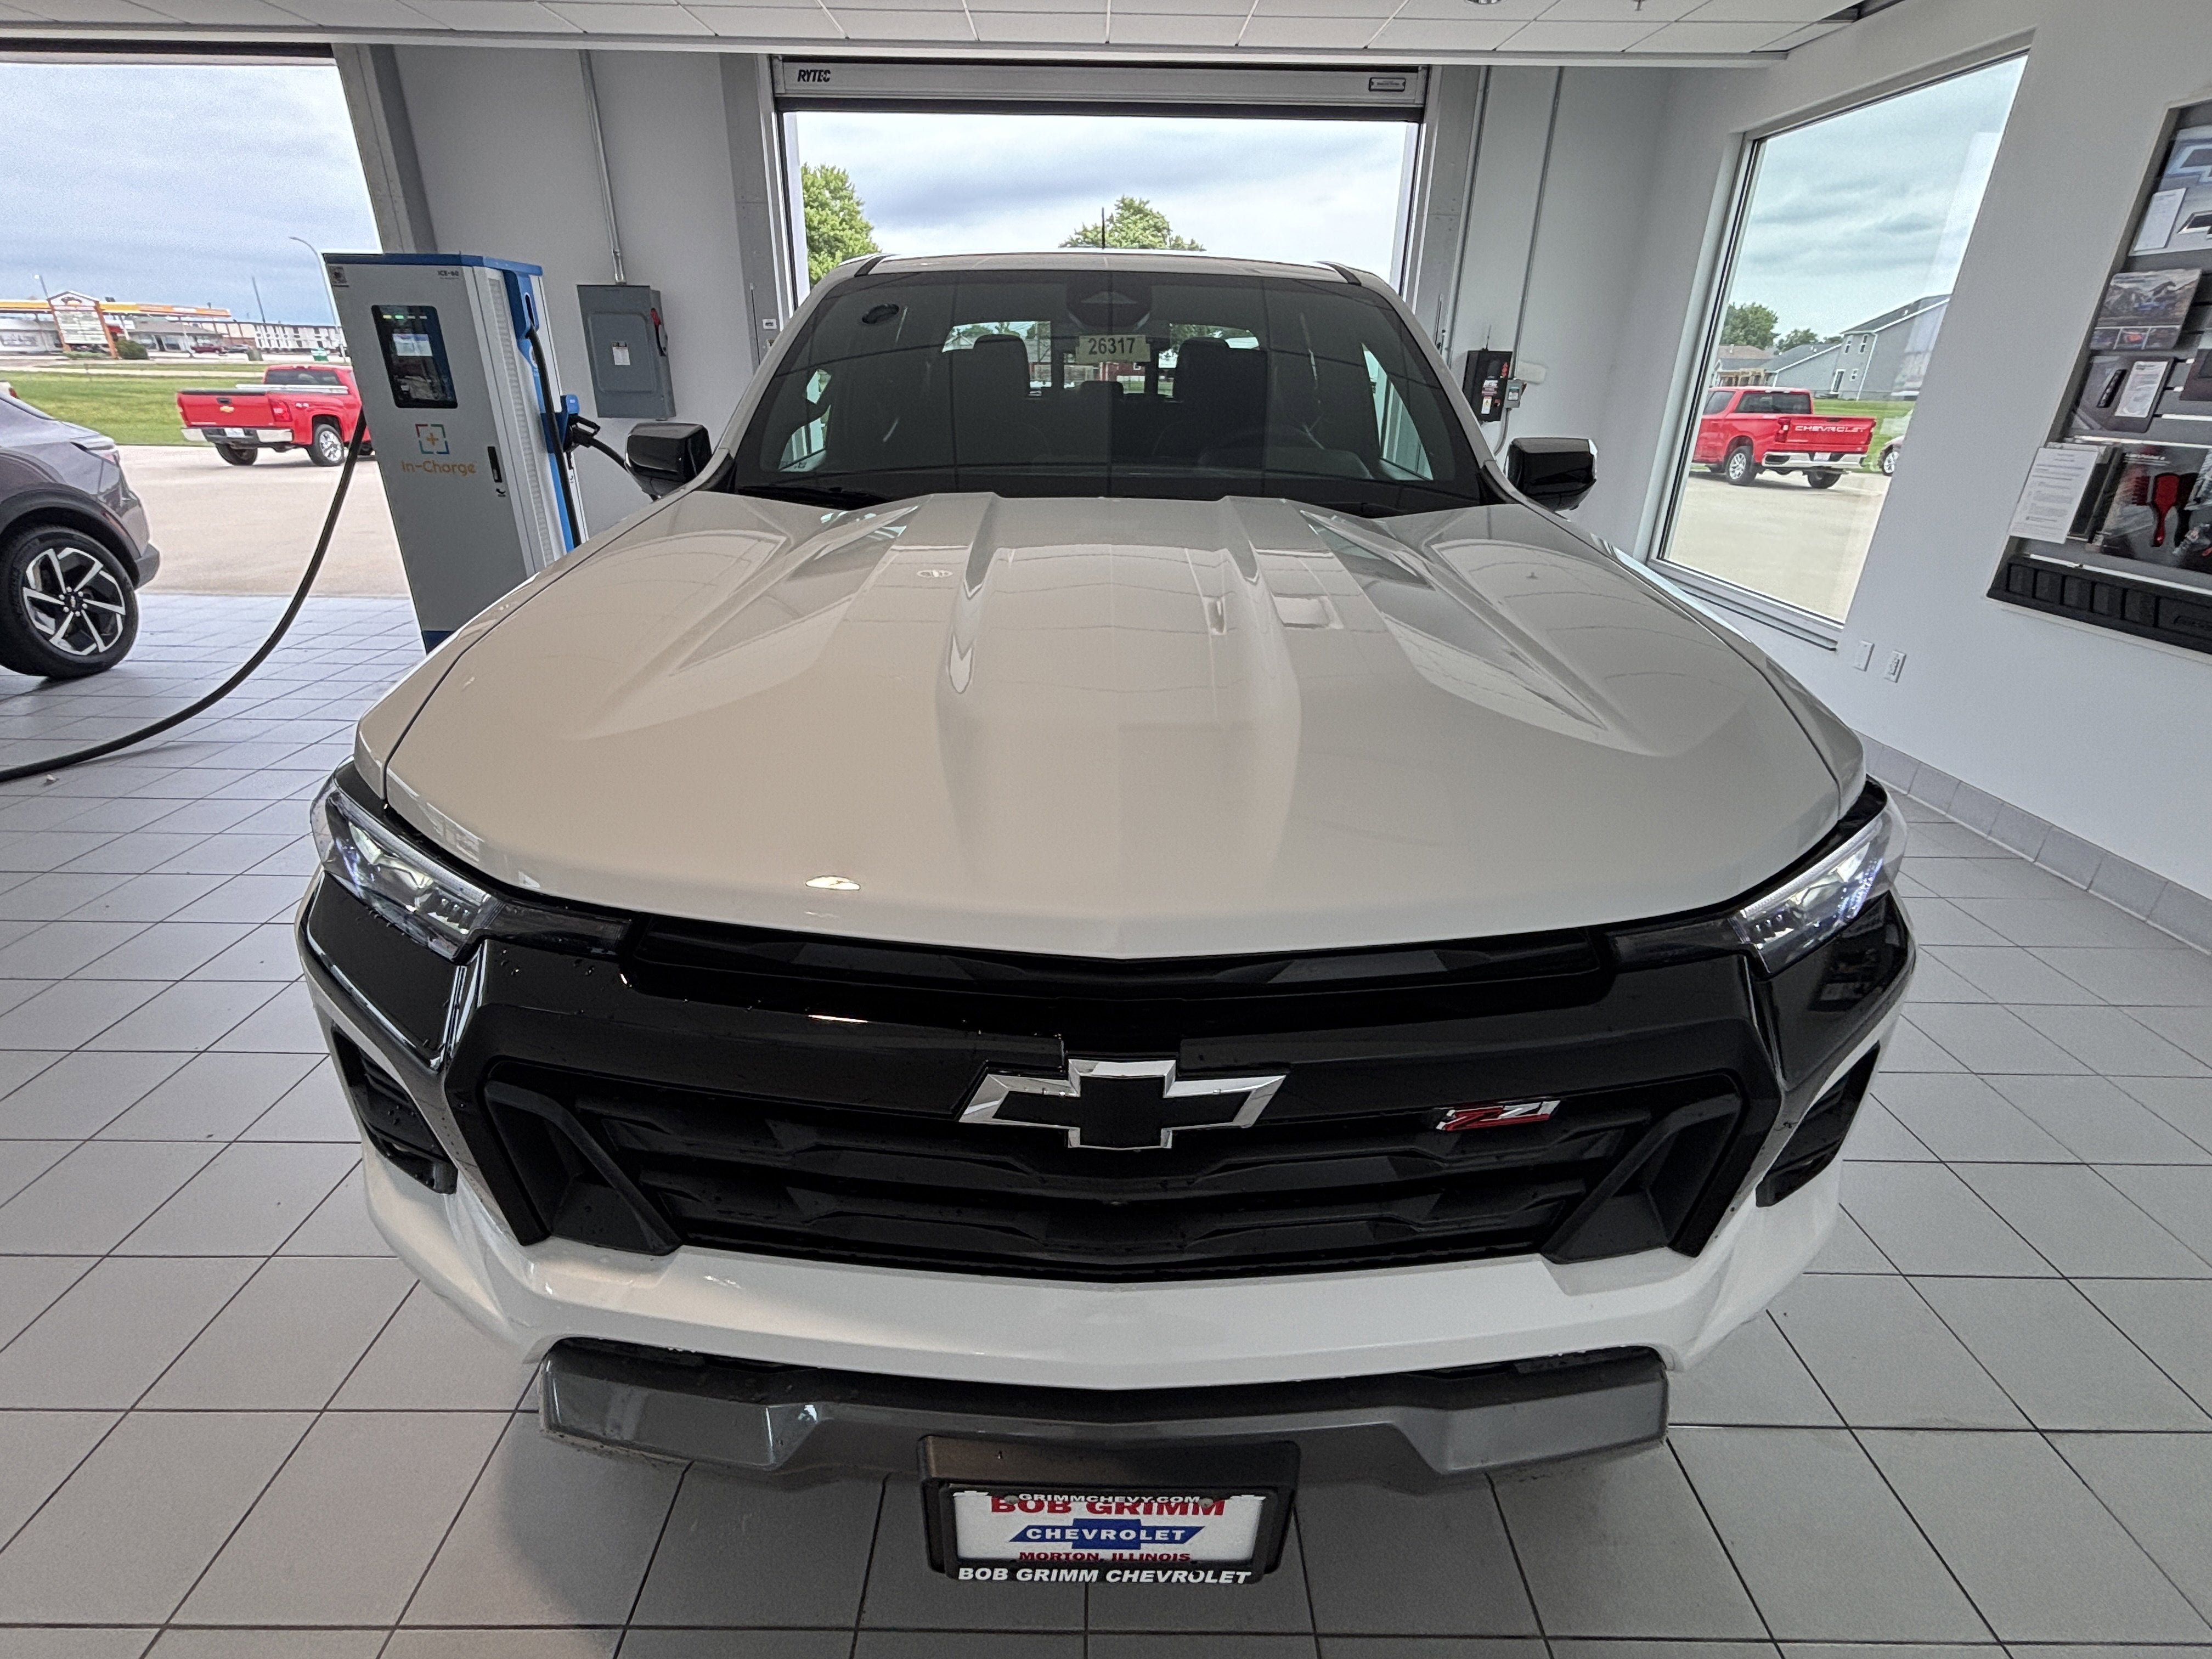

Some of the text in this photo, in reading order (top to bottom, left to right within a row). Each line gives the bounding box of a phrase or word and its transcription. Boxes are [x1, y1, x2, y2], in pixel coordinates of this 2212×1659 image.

[797, 69, 831, 82] RYTEC
[1088, 337, 1135, 355] 26317
[401, 460, 476, 476] In-Charge
[1434, 1099, 1561, 1131] Z71
[991, 1496, 1226, 1515] BOB GRIMM
[1019, 1493, 1200, 1503] GRIMMCHEVY.COM
[1026, 1528, 1186, 1541] CHEVROLET
[1111, 1553, 1190, 1561] ILLINOIS
[958, 1567, 1252, 1584] BOB GRIMM CHEVROLET
